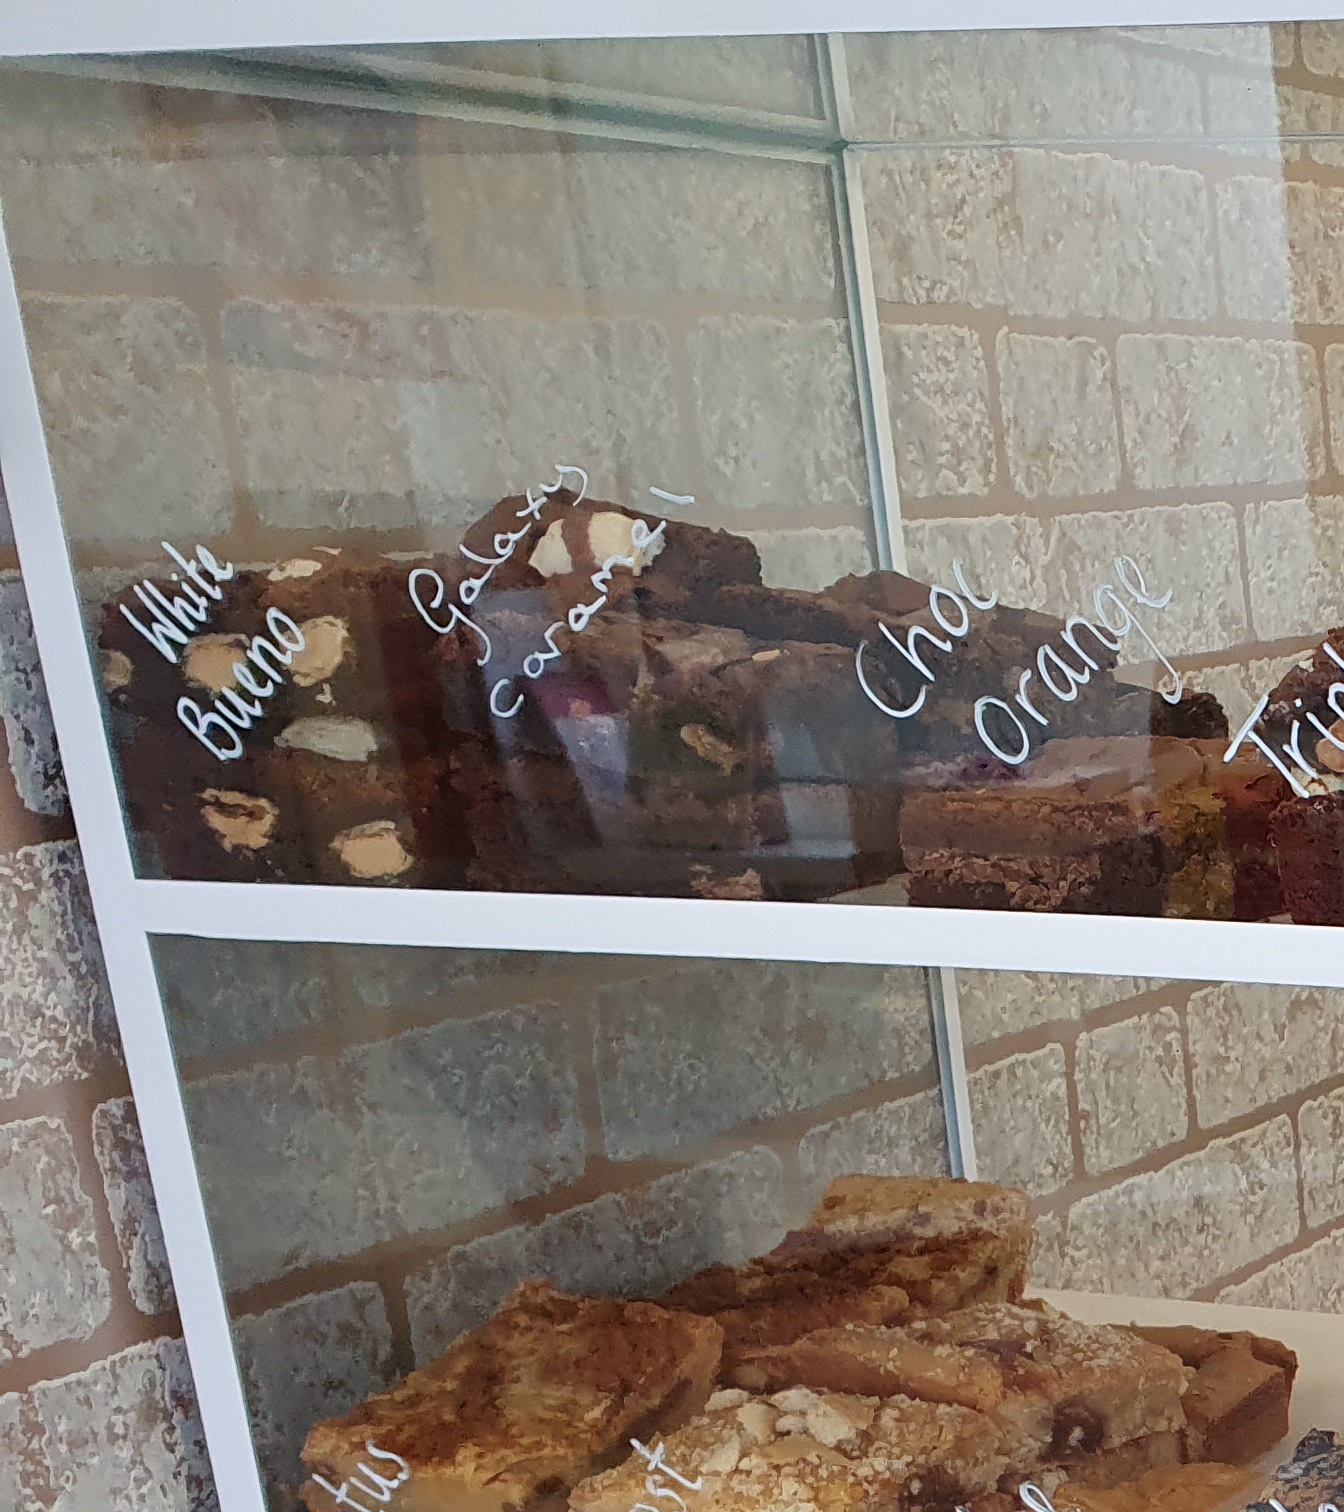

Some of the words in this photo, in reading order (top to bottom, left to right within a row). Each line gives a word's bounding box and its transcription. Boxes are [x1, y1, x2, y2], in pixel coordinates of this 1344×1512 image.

[119, 541, 234, 664] White
[855, 558, 1000, 719] Choc
[972, 555, 1173, 766] Orange
[176, 606, 307, 764] Bueno
